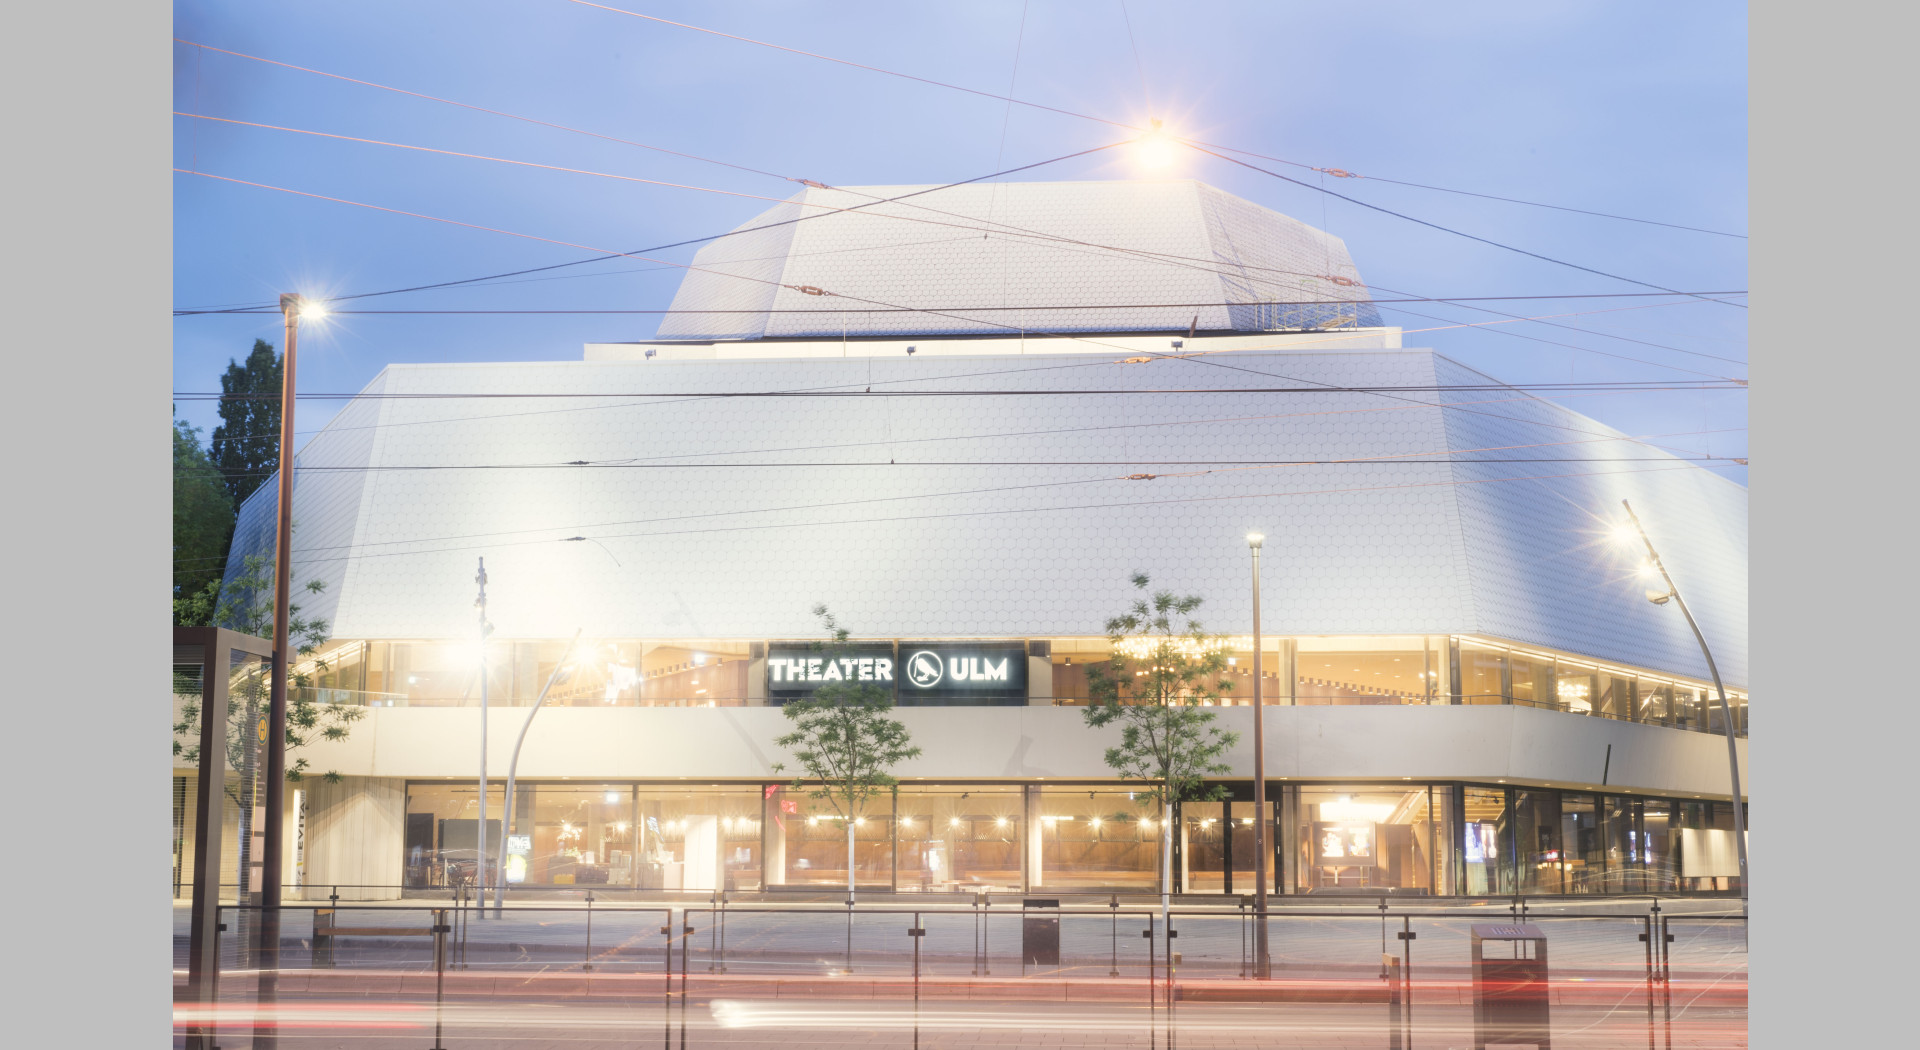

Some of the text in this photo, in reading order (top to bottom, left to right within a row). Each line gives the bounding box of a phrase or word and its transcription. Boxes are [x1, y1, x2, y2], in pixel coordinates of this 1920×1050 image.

[768, 657, 1008, 681] THEATER ULM
[297, 802, 306, 851] EVITA
